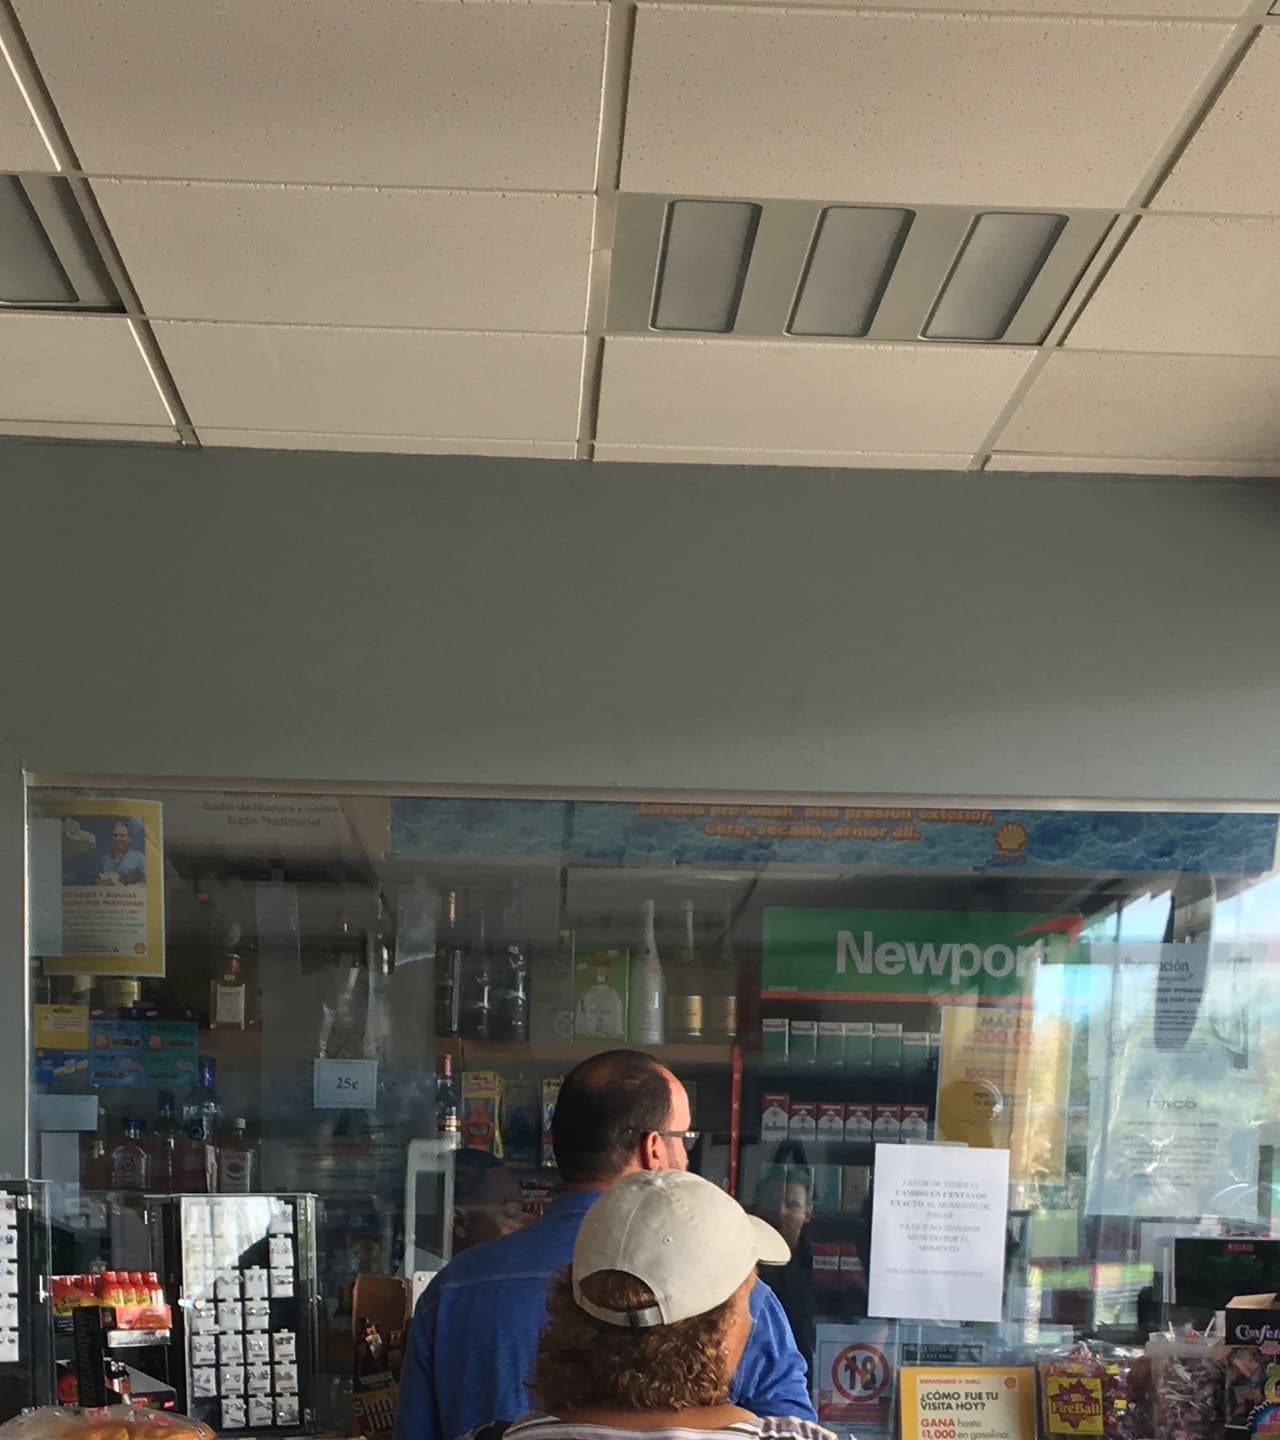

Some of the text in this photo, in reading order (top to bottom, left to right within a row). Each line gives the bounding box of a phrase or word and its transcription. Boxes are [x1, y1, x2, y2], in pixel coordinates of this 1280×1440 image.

[920, 1390, 999, 1402] ¿CÓMO FUE TU
[920, 1402, 986, 1411] VISITA HOY?
[1050, 1401, 1101, 1416] FireBall
[920, 1418, 982, 1428] GANA hasta
[921, 1429, 1009, 1440] $1,000 en gasolina
